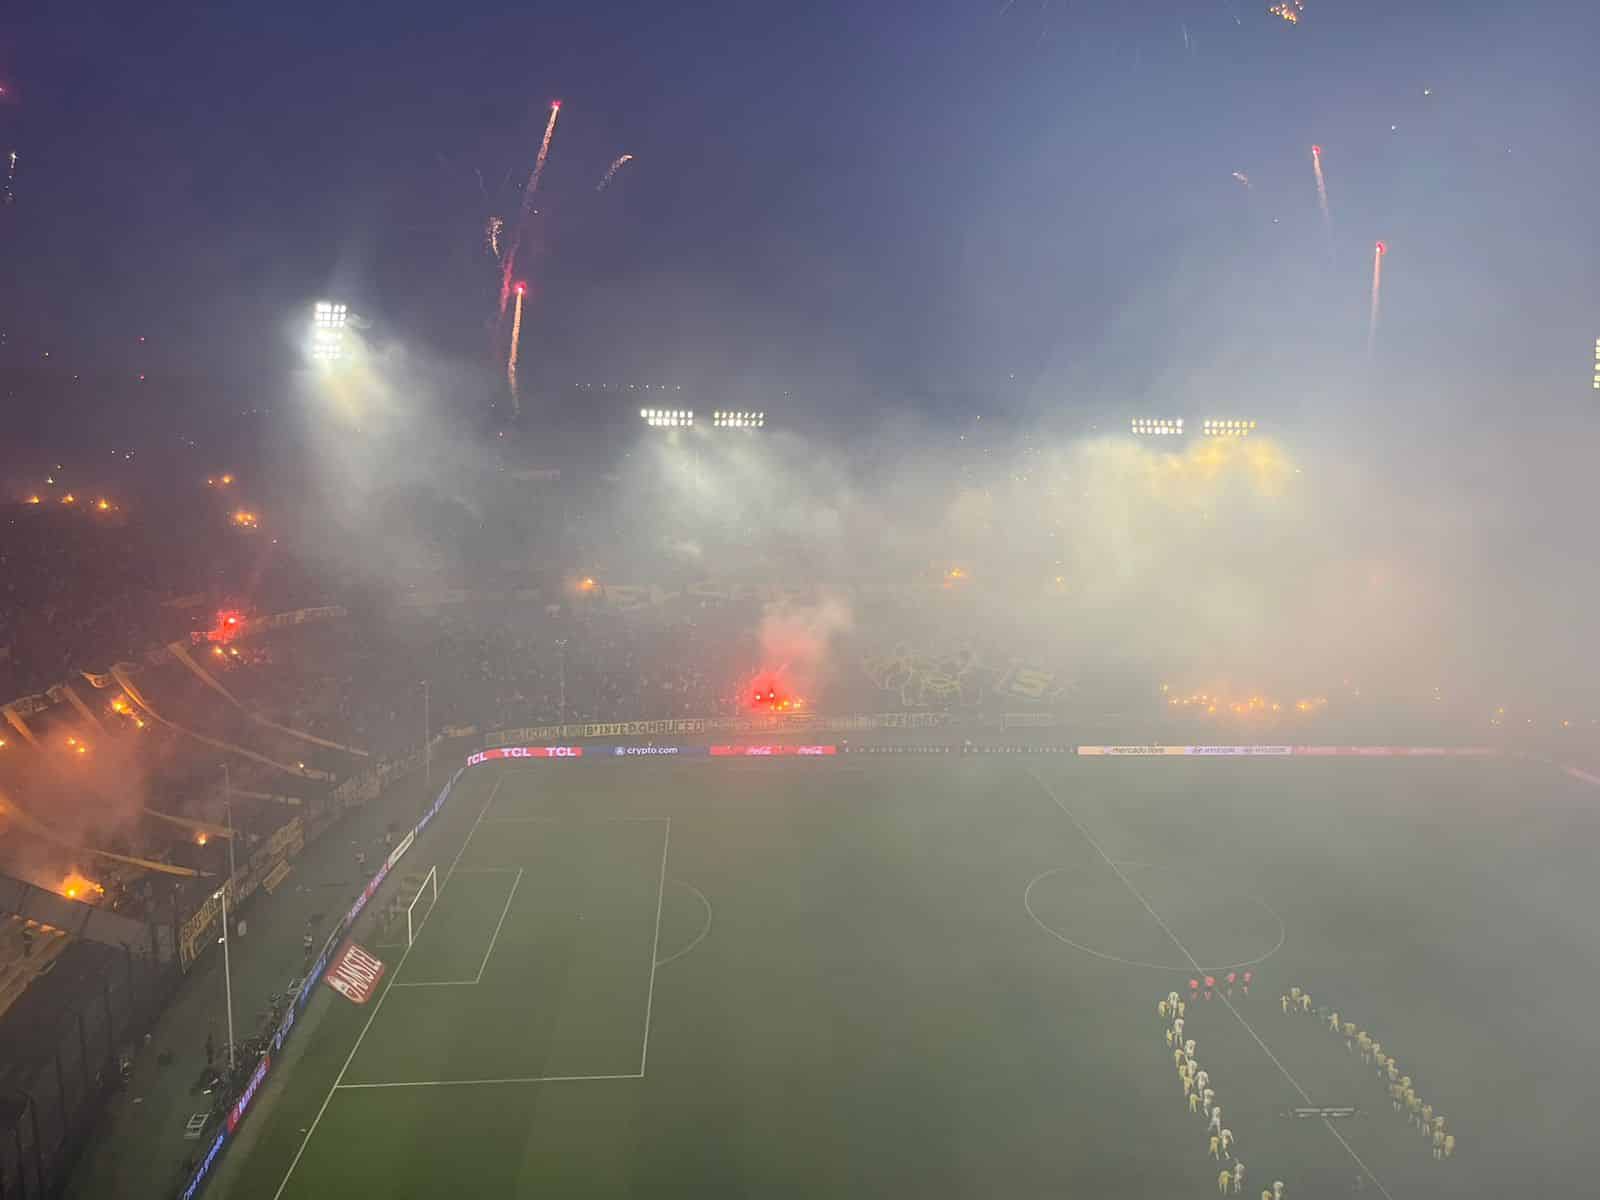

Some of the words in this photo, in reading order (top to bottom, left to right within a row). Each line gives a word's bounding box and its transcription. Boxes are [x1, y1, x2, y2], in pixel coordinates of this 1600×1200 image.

[501, 748, 531, 757] TCL
[546, 747, 576, 757] TCL
[627, 745, 678, 756] crypto.com
[467, 752, 488, 765] TCL
[335, 944, 384, 1001] AMSTEL
